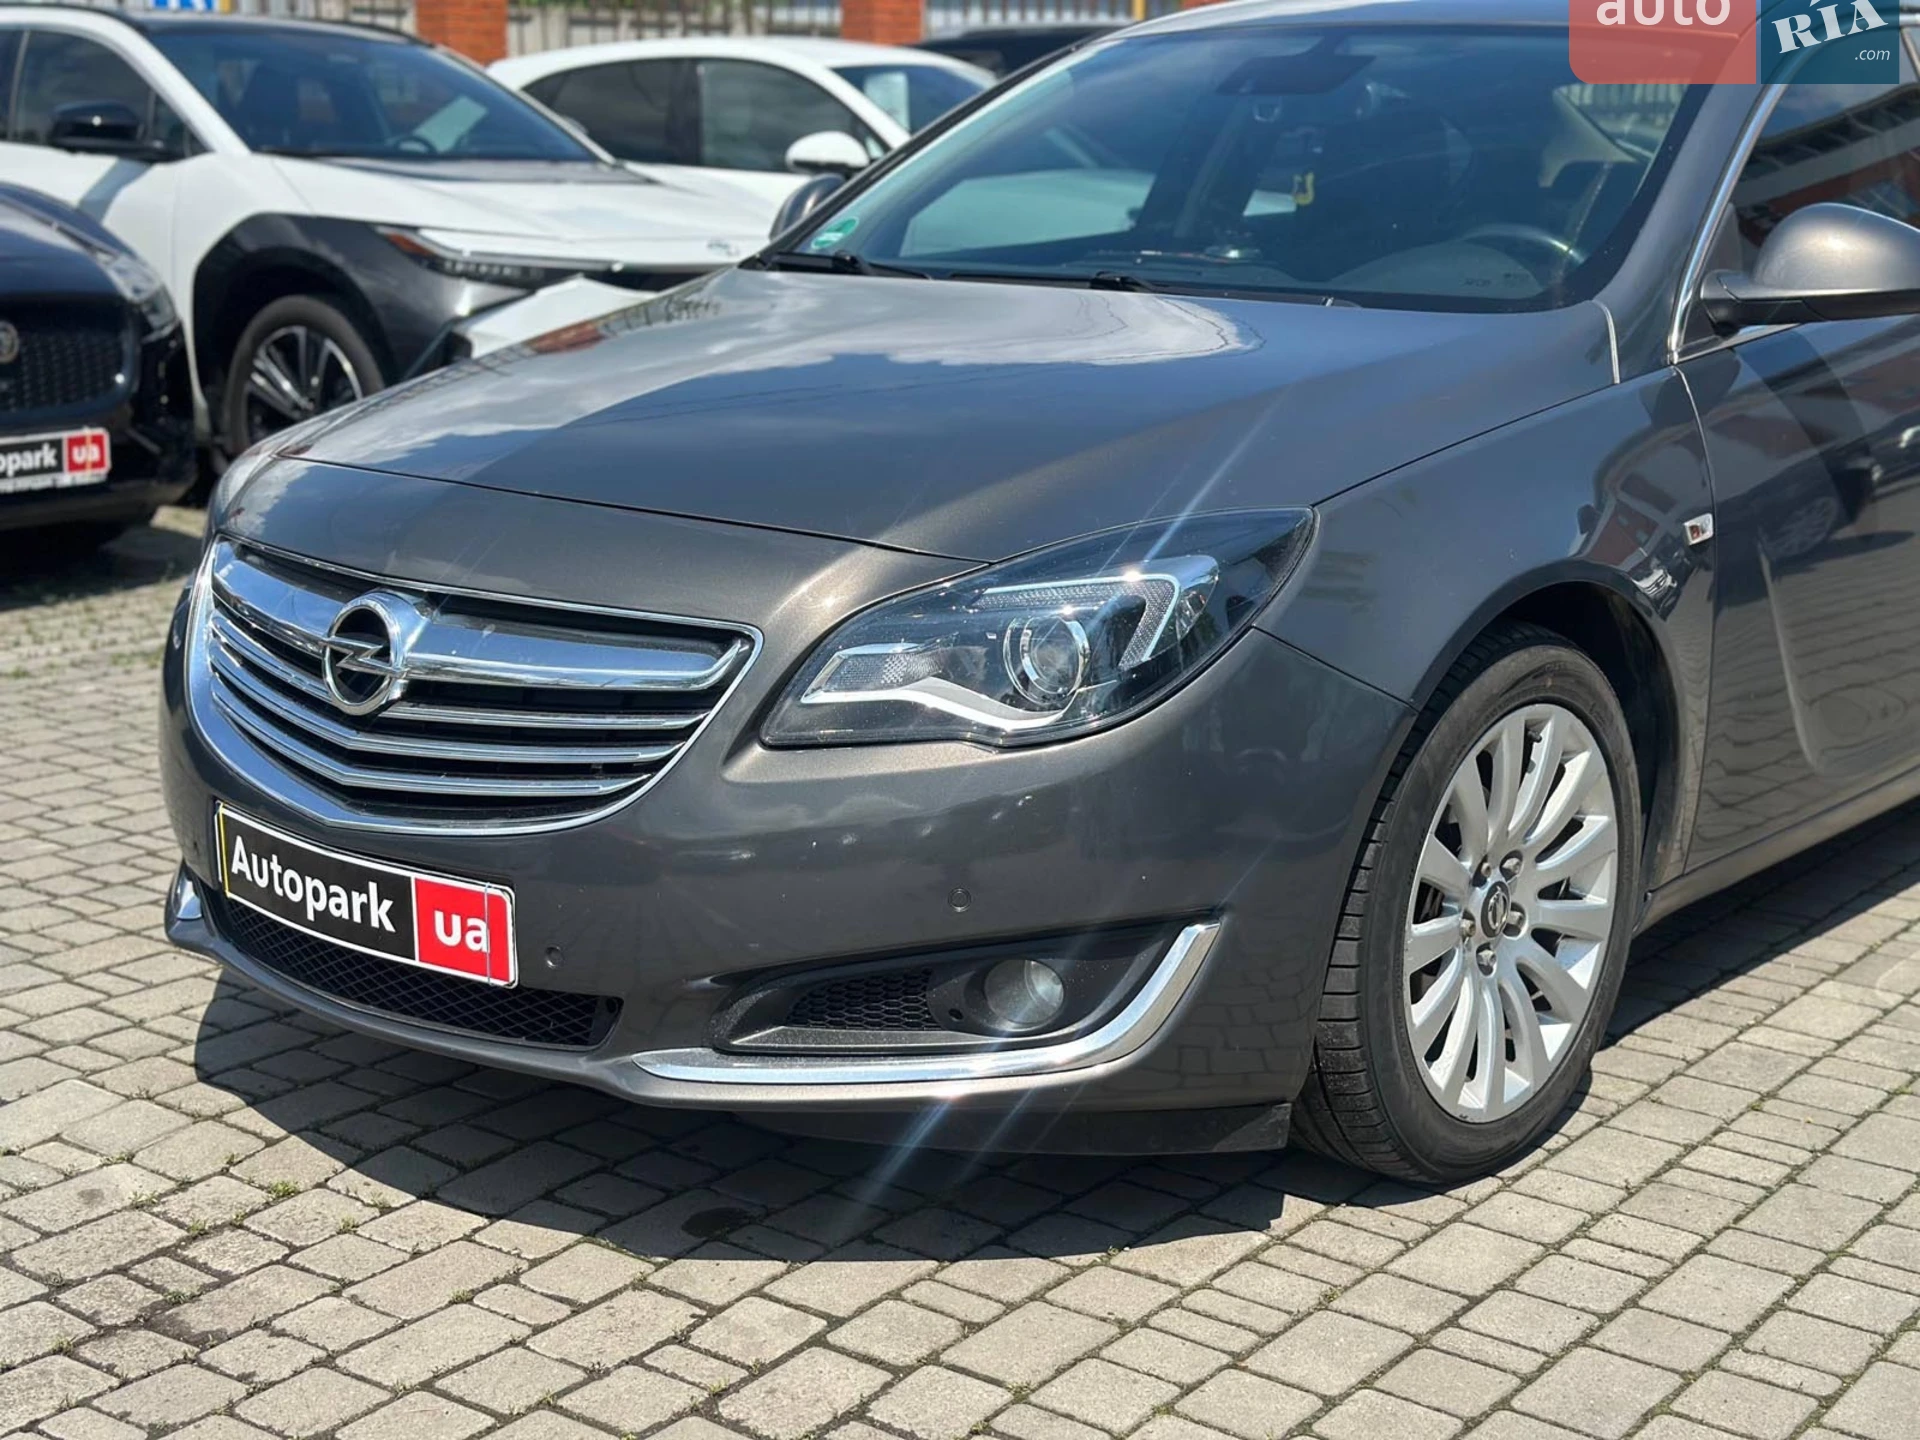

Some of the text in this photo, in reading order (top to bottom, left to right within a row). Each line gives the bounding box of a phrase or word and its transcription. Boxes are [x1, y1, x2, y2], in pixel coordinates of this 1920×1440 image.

[72, 443, 101, 464] ua
[231, 835, 490, 954] Autopark ua
